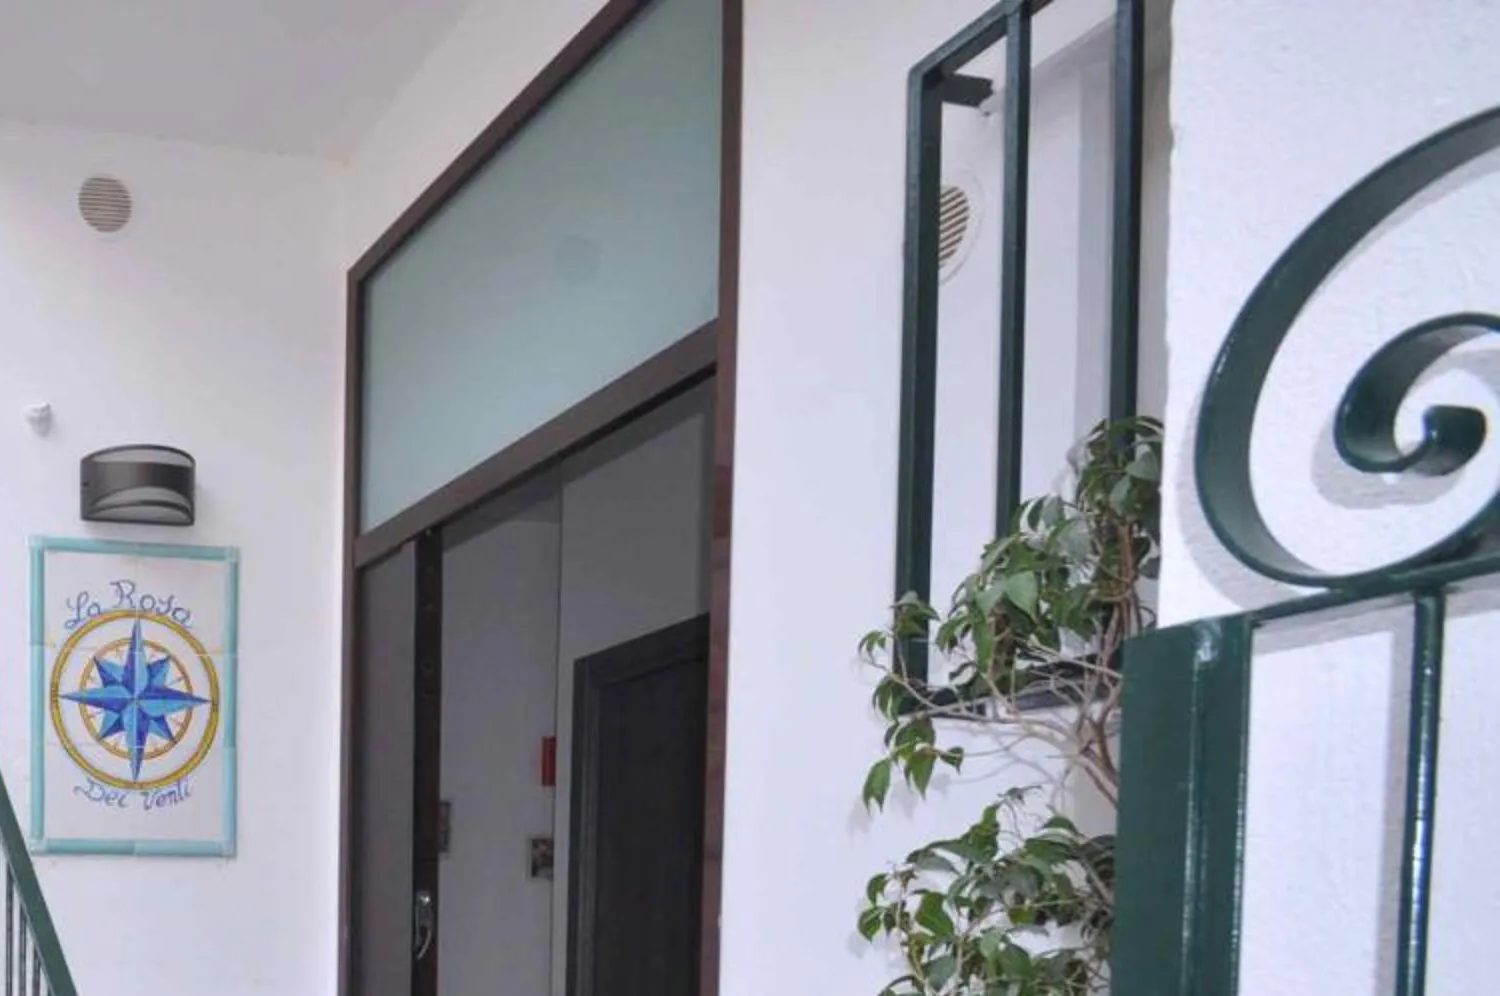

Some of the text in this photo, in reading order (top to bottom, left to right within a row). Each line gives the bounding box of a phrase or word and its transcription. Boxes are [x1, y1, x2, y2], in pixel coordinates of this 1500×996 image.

[64, 579, 194, 629] La Rosa
[73, 777, 128, 808] Dei
